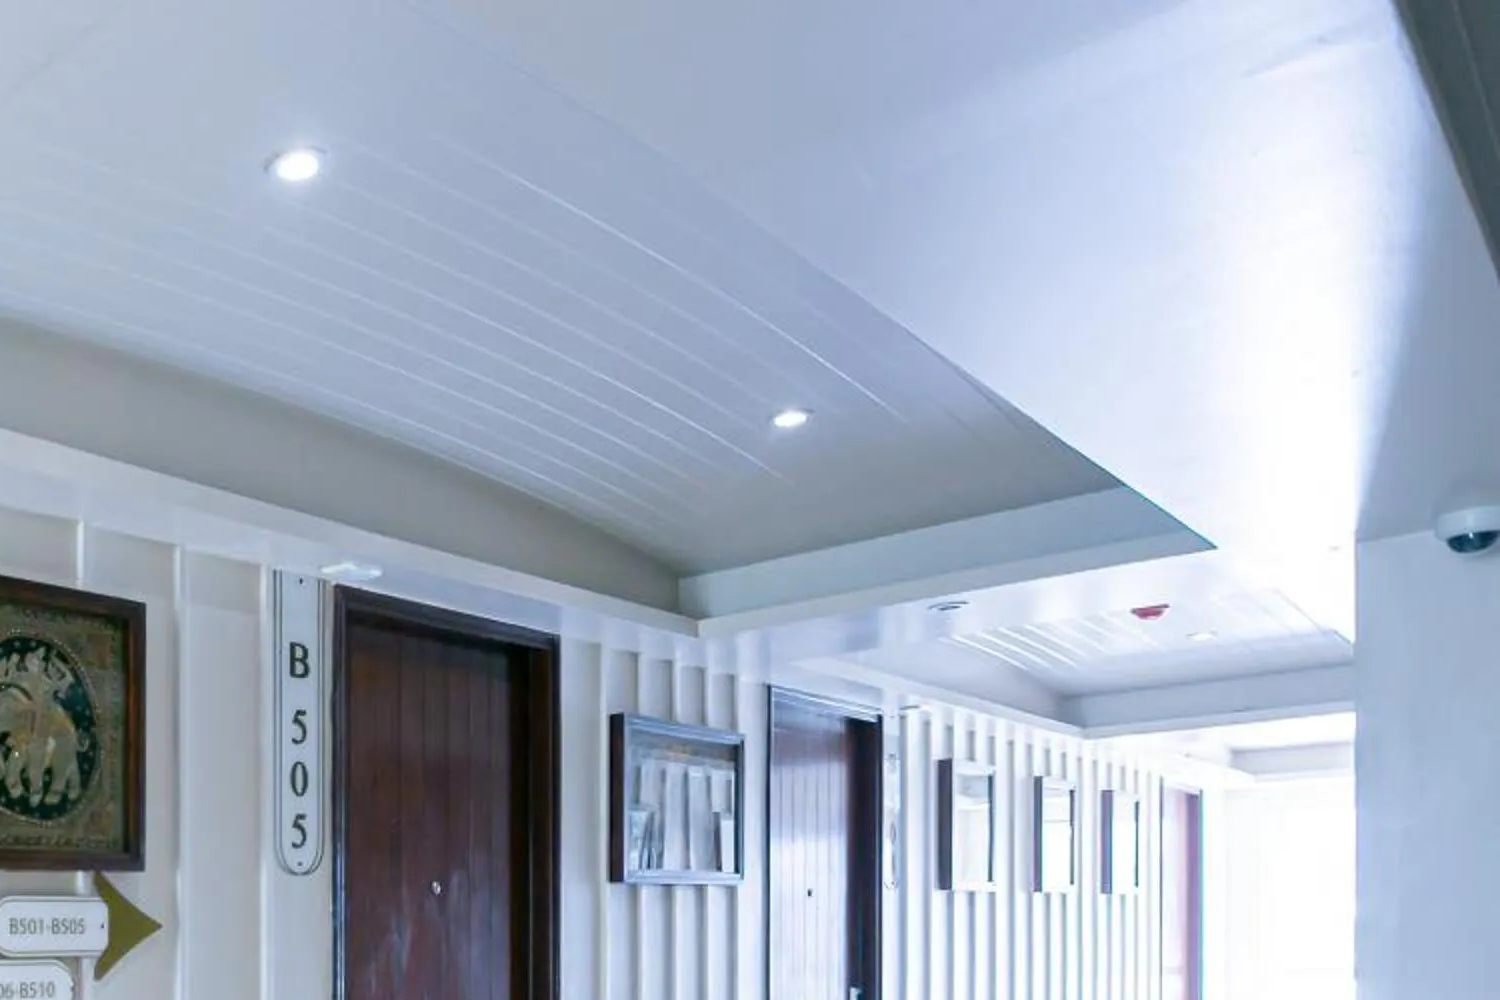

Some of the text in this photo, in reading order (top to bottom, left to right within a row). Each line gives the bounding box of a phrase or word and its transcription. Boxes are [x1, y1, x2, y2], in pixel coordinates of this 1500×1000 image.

[289, 641, 310, 849] B 505
[8, 917, 86, 936] B501-B505
